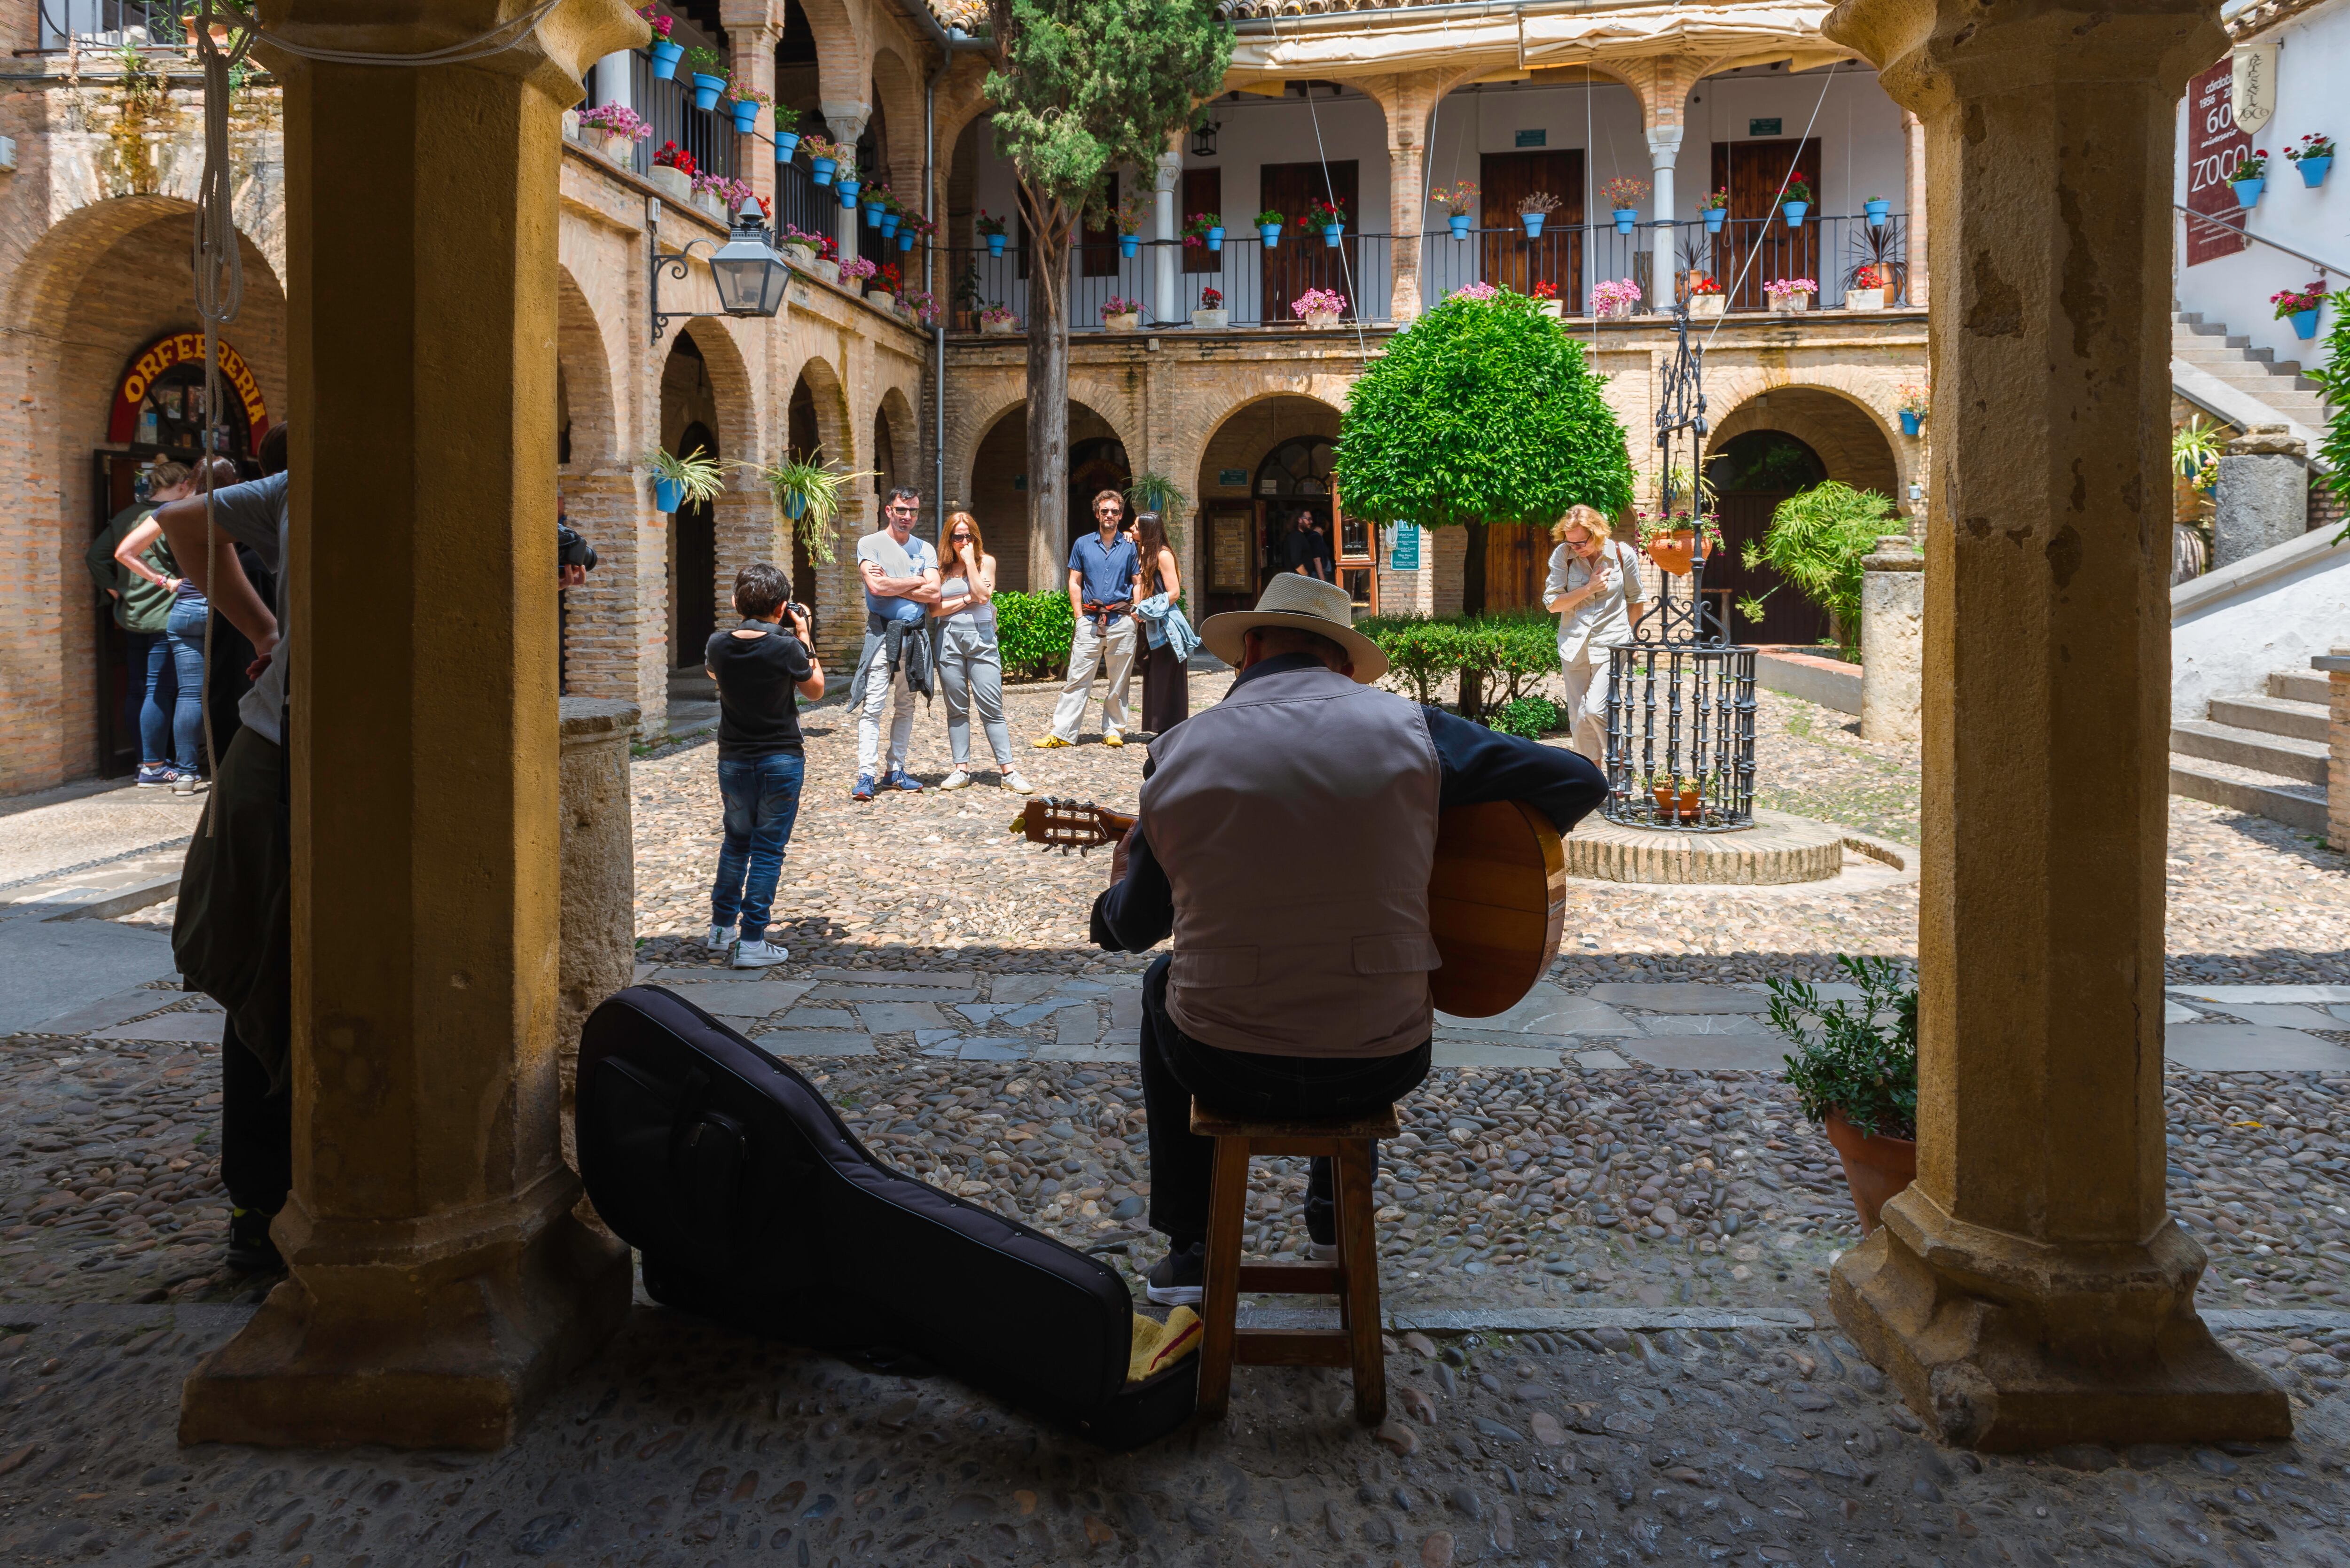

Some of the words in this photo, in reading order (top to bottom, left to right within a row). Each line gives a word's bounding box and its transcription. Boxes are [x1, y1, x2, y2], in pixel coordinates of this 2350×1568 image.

[2199, 94, 2216, 109] 1956
[2223, 86, 2232, 99] 20
[2206, 103, 2232, 133] 60
[2237, 108, 2270, 122] ZOCO
[2200, 128, 2238, 148] aniversario
[2191, 144, 2248, 192] ZOCO
[163, 771, 179, 781] N
